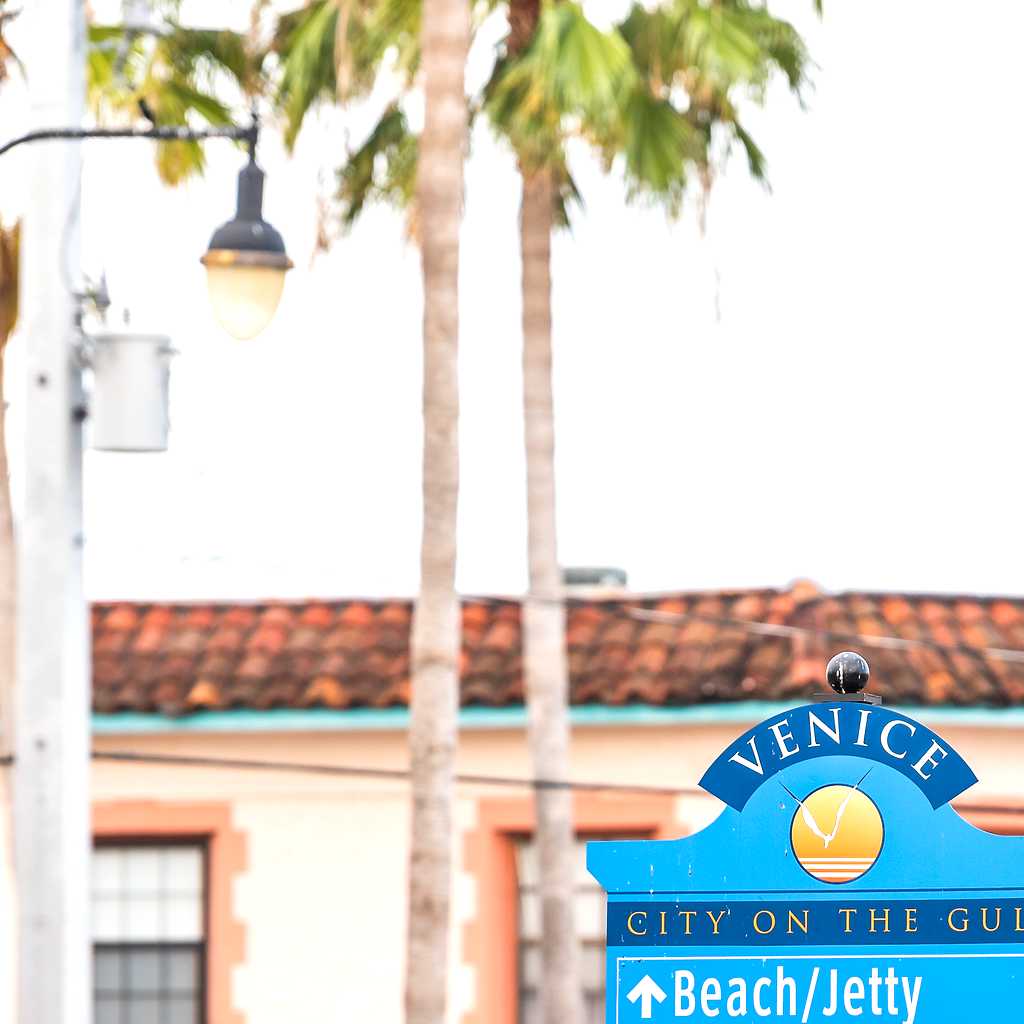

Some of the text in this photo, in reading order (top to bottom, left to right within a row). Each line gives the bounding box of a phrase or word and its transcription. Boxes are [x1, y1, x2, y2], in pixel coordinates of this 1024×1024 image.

[728, 708, 949, 781] VENICE
[626, 909, 726, 937] CITY
[753, 909, 809, 936] ON
[838, 908, 919, 934] THE
